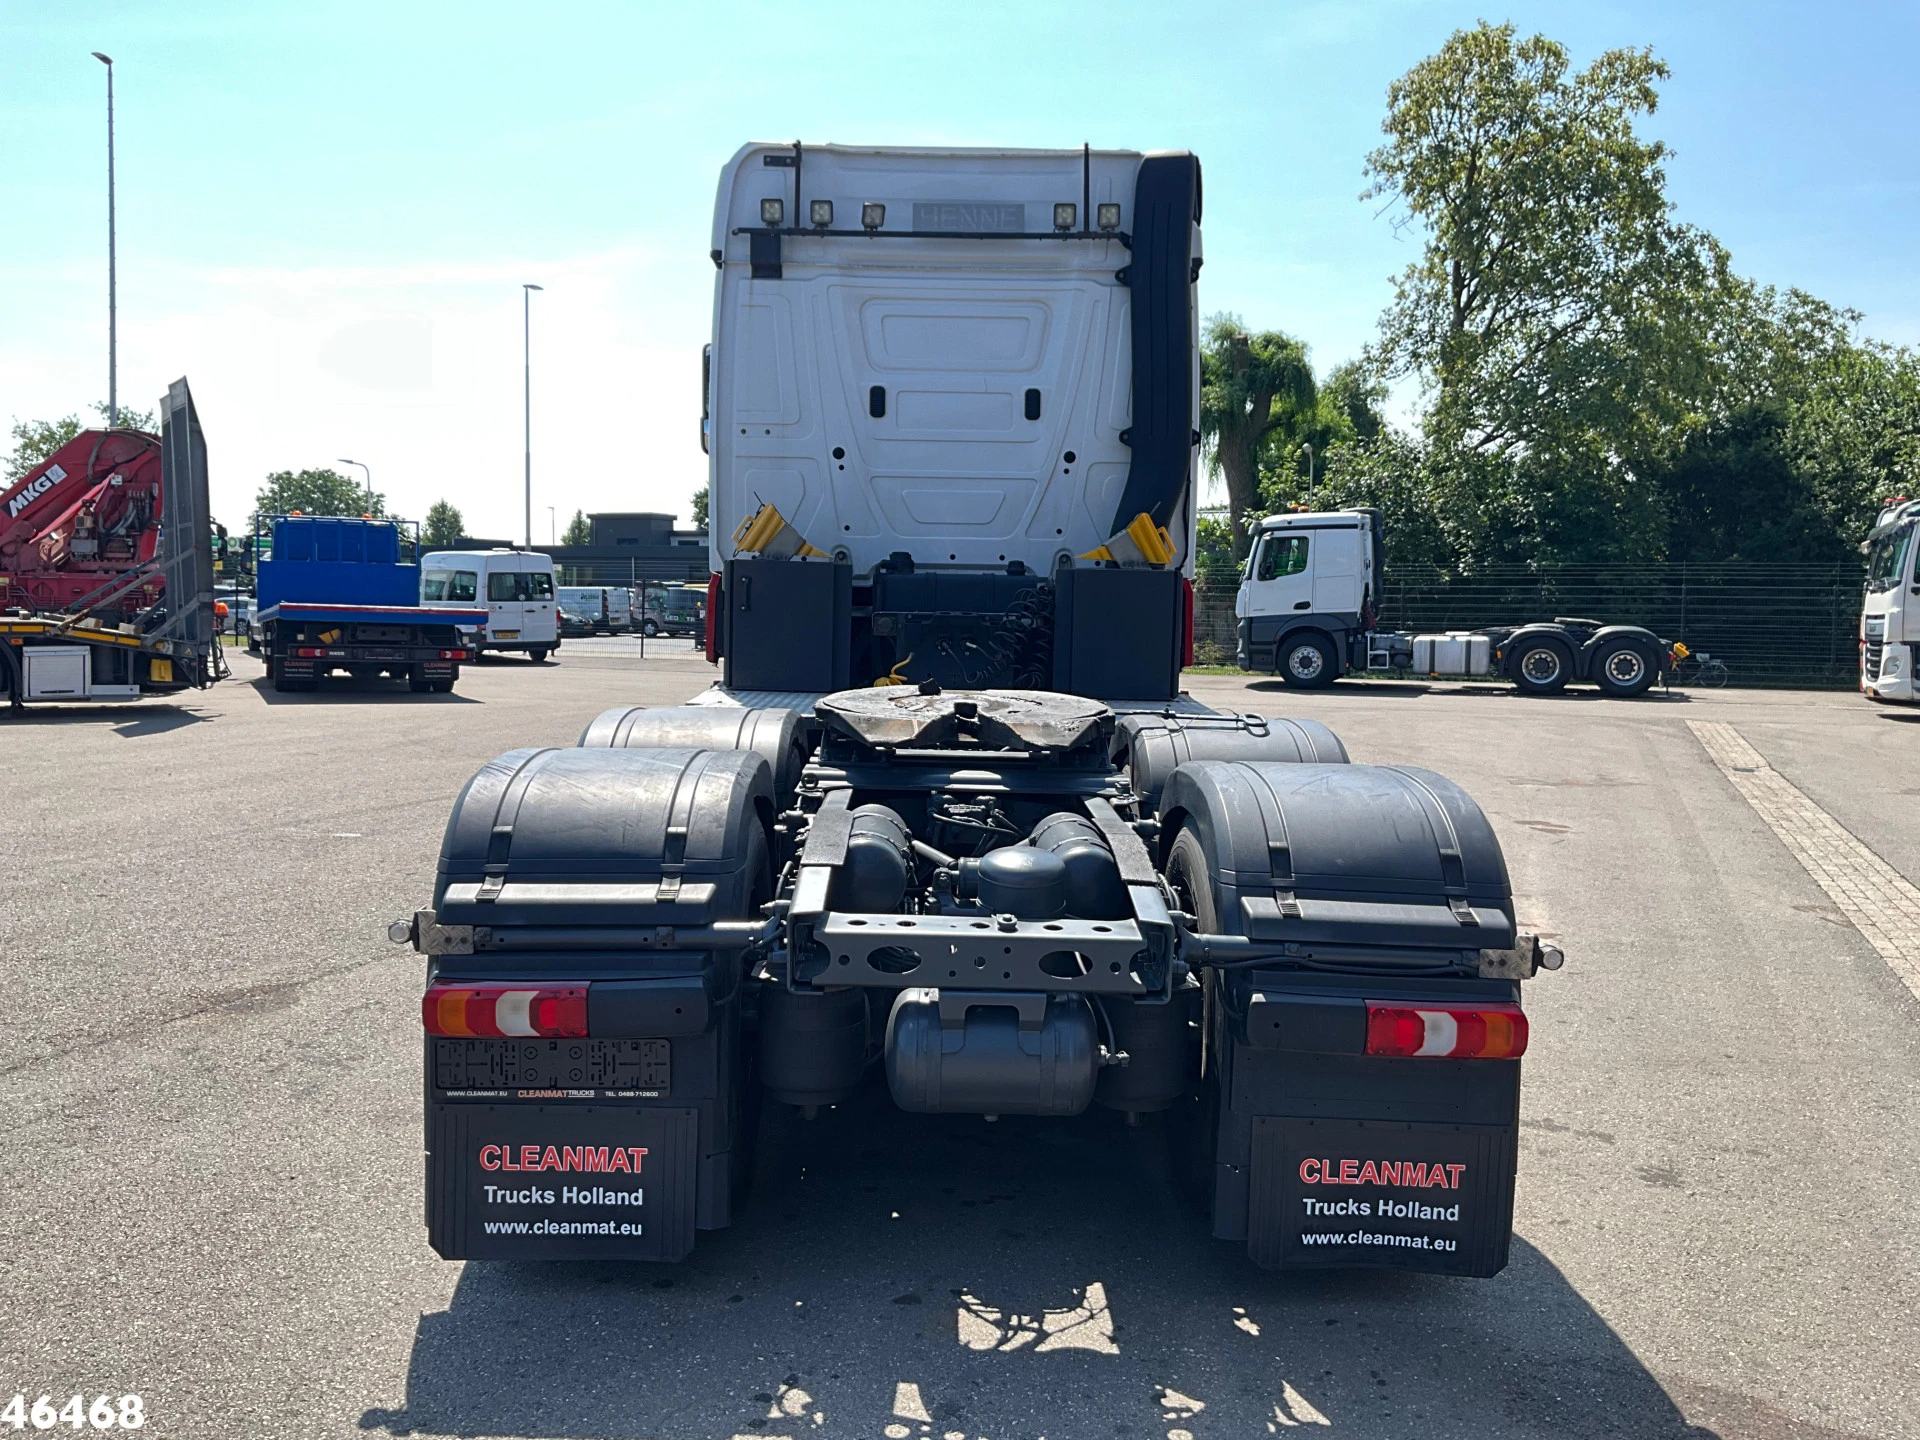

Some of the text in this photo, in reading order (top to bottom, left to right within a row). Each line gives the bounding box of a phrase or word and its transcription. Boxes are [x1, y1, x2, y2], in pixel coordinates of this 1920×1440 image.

[9, 475, 53, 518] MKG
[479, 1144, 648, 1173] CLEANMAT
[1299, 1158, 1466, 1189] CLEANMAT
[484, 1185, 643, 1206] Trucks Holland
[1303, 1198, 1460, 1221] Trucks Holland
[484, 1219, 643, 1236] www.cleanmat.eu
[1301, 1230, 1457, 1252] www.cleanmat.eu
